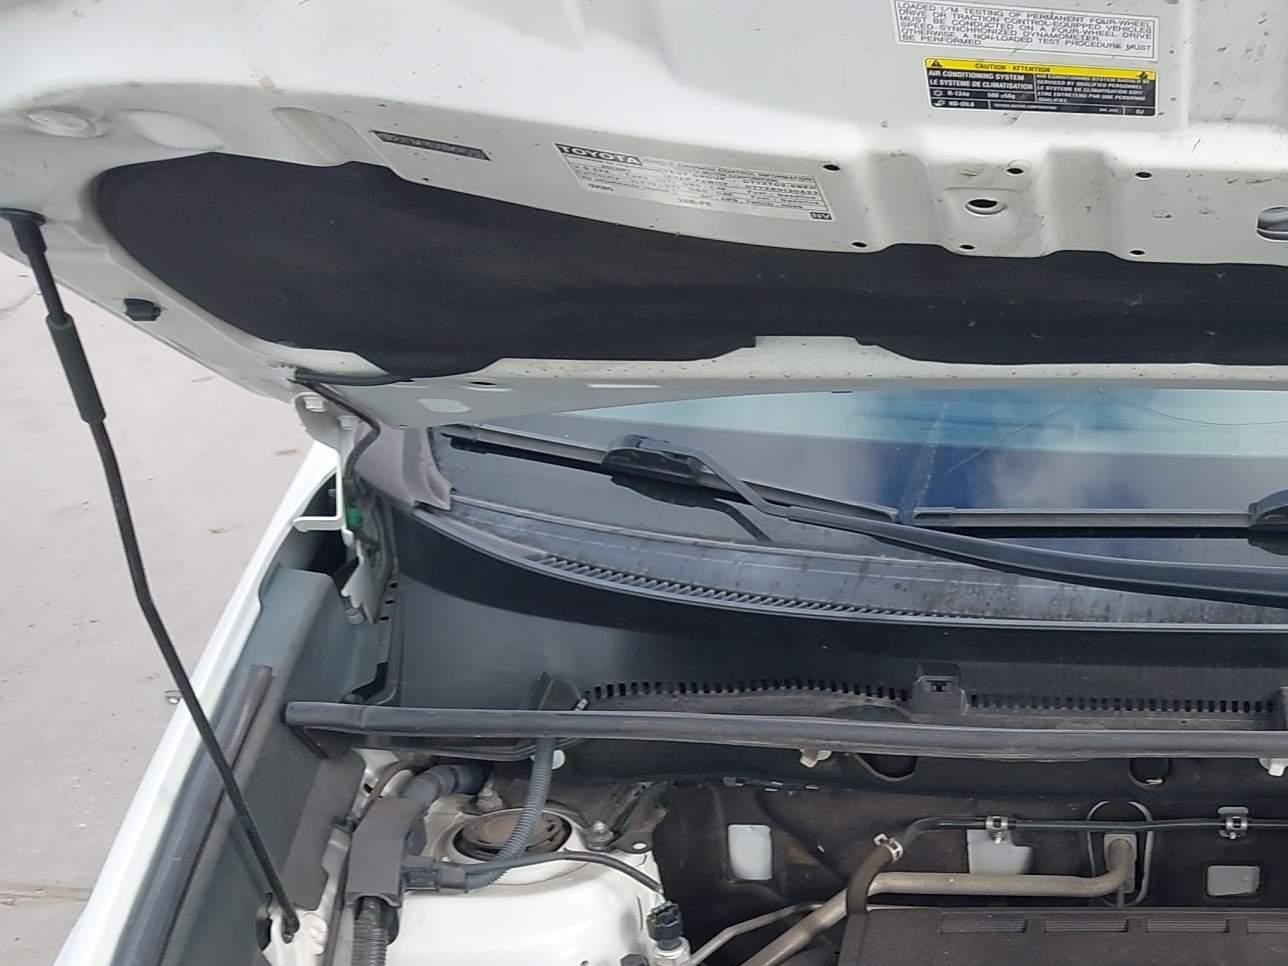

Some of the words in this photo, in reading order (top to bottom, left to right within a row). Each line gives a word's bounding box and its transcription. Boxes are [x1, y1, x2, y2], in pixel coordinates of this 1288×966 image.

[952, 13, 1000, 22] TRACTION
[964, 8, 1004, 17] TESTING
[1026, 13, 1084, 22] PERMANENT
[901, 22, 934, 30] SPEED
[939, 24, 1017, 36] SYNCHRONIZED
[952, 20, 1014, 30] CONDUCTED
[1052, 27, 1117, 37] FOUR-WHEEL
[559, 145, 640, 164] TOYOTA
